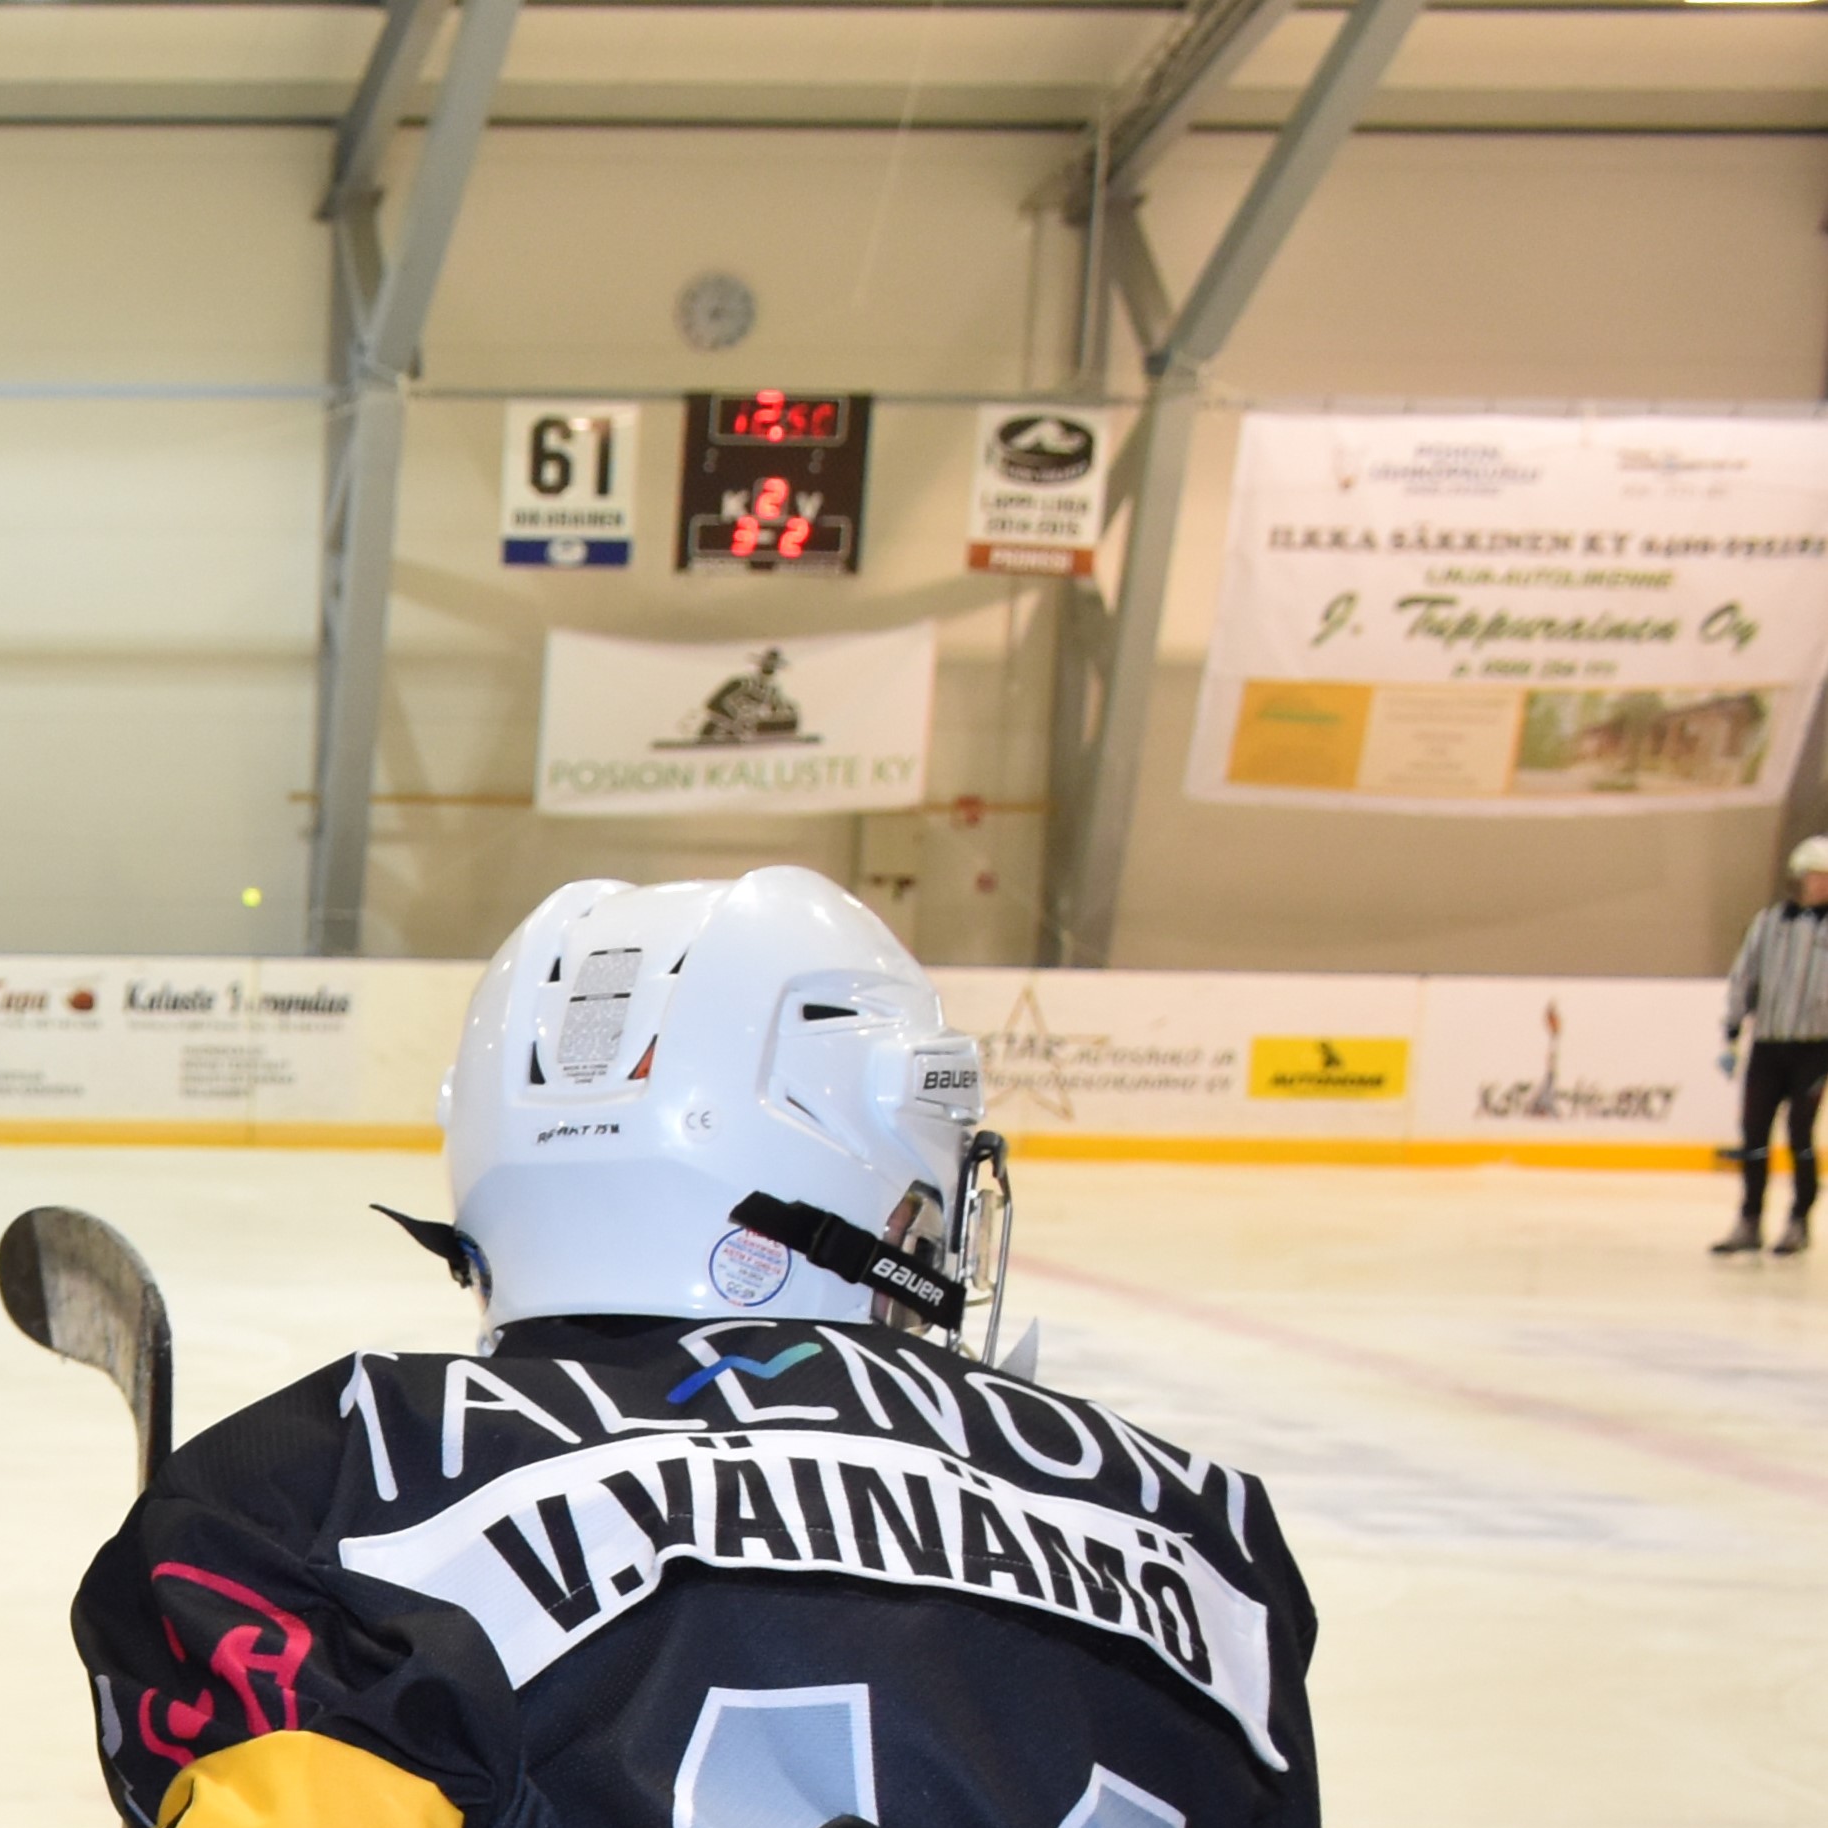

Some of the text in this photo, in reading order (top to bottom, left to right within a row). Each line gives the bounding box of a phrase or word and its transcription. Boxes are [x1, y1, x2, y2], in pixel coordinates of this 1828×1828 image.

[530, 417, 612, 496] 61
[1698, 599, 1761, 653] Oy
[871, 1257, 945, 1309] BAUER
